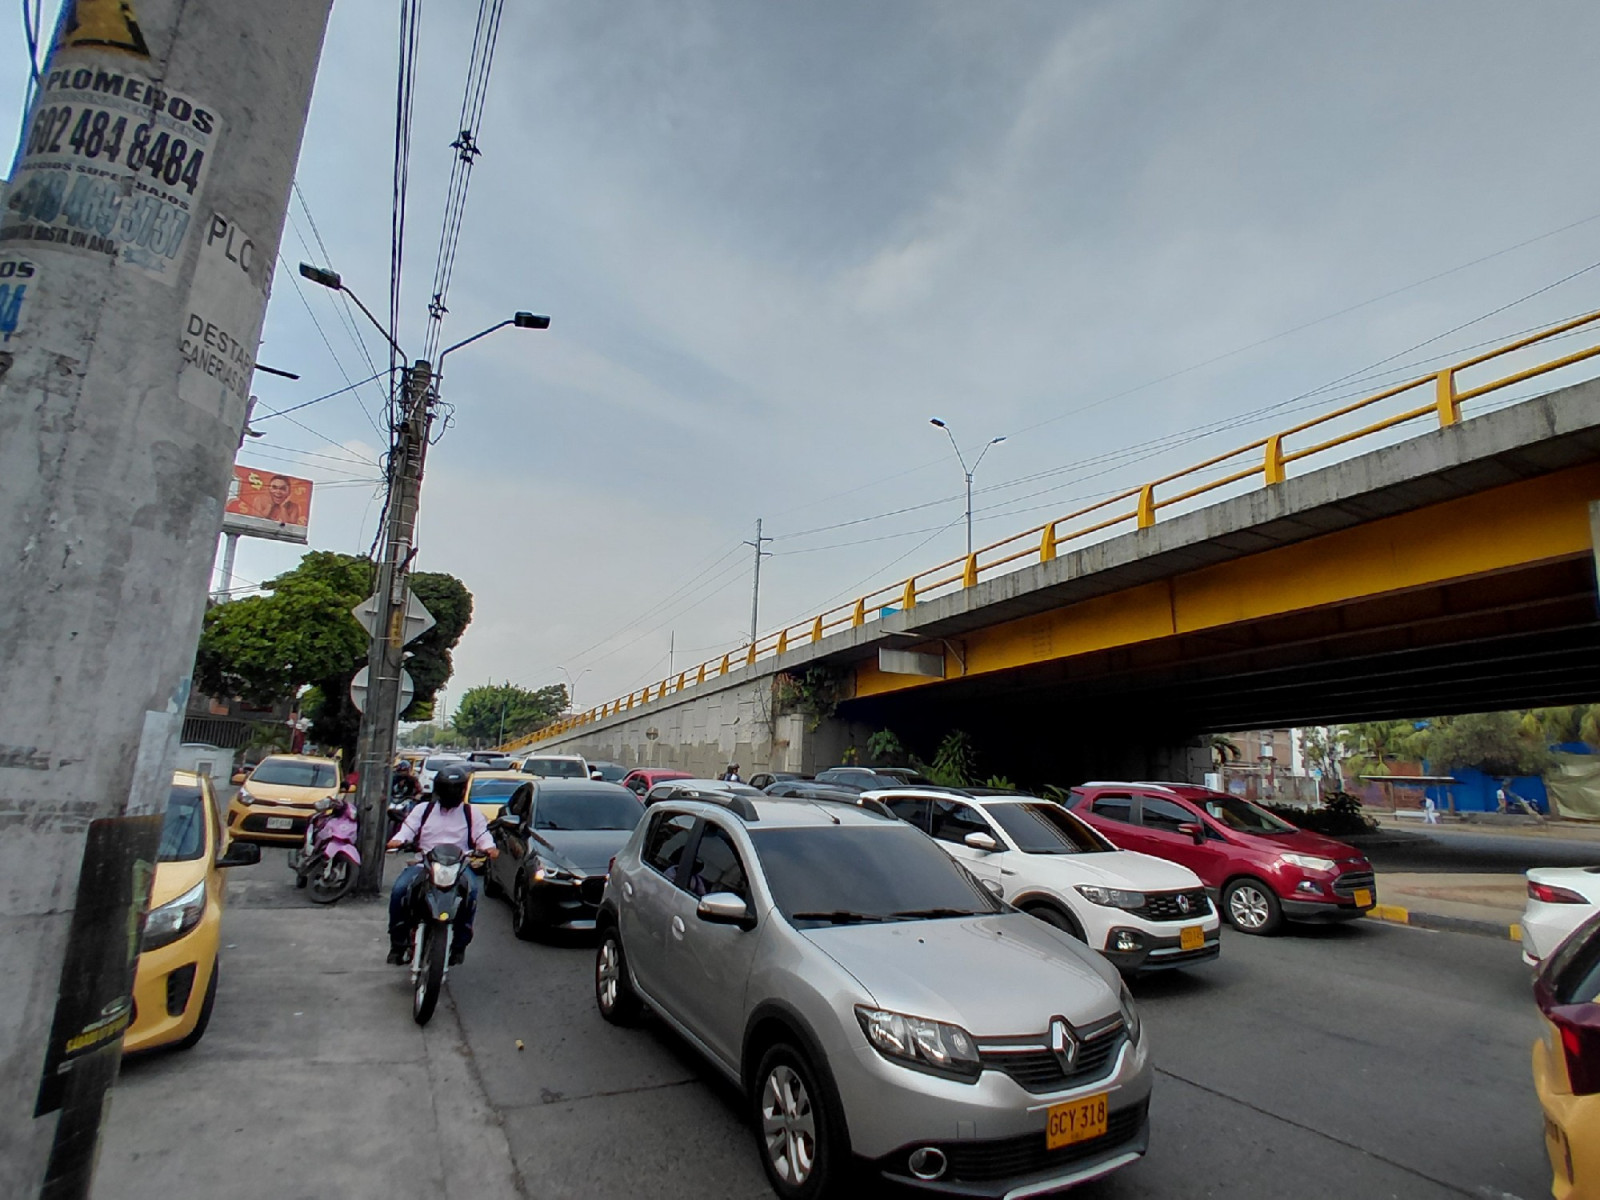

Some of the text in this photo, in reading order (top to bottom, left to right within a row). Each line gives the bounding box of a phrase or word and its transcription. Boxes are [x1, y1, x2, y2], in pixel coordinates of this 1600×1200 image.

[46, 68, 214, 134] PLOMEROS
[69, 108, 128, 162] 484
[126, 123, 205, 196] 8484
[1050, 1101, 1105, 1137] GCY 318
